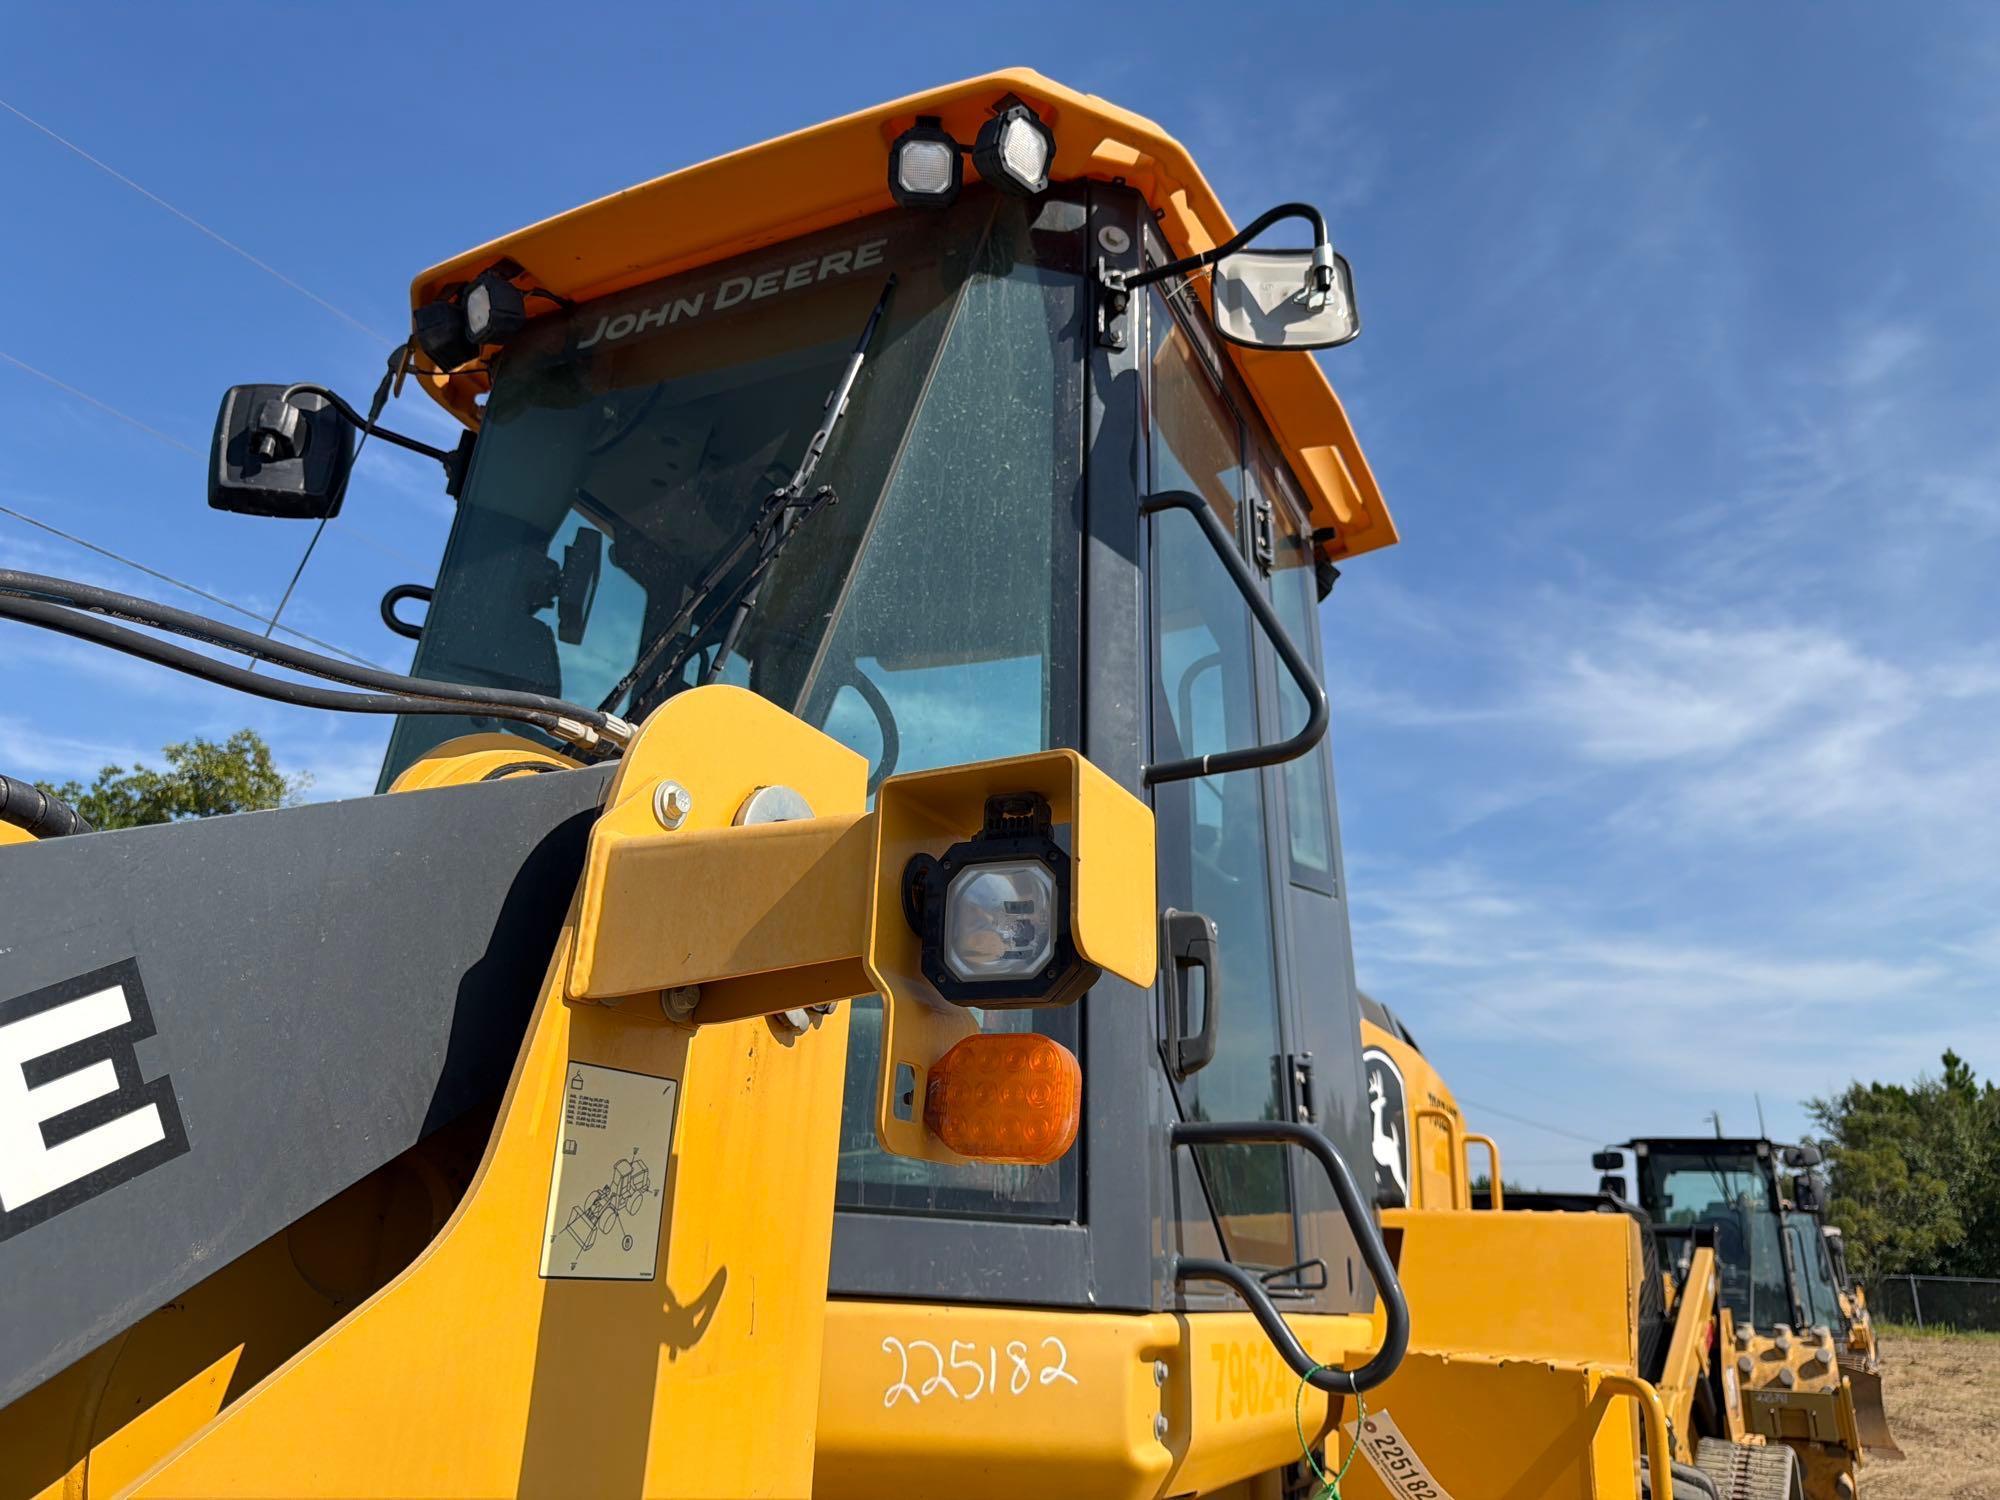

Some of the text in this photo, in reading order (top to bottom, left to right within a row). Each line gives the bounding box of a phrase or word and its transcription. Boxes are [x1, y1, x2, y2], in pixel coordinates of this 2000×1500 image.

[576, 238, 889, 350] JOHN DEERE
[881, 1335, 1079, 1408] 225182
[1373, 1434, 1438, 1500] 225182
